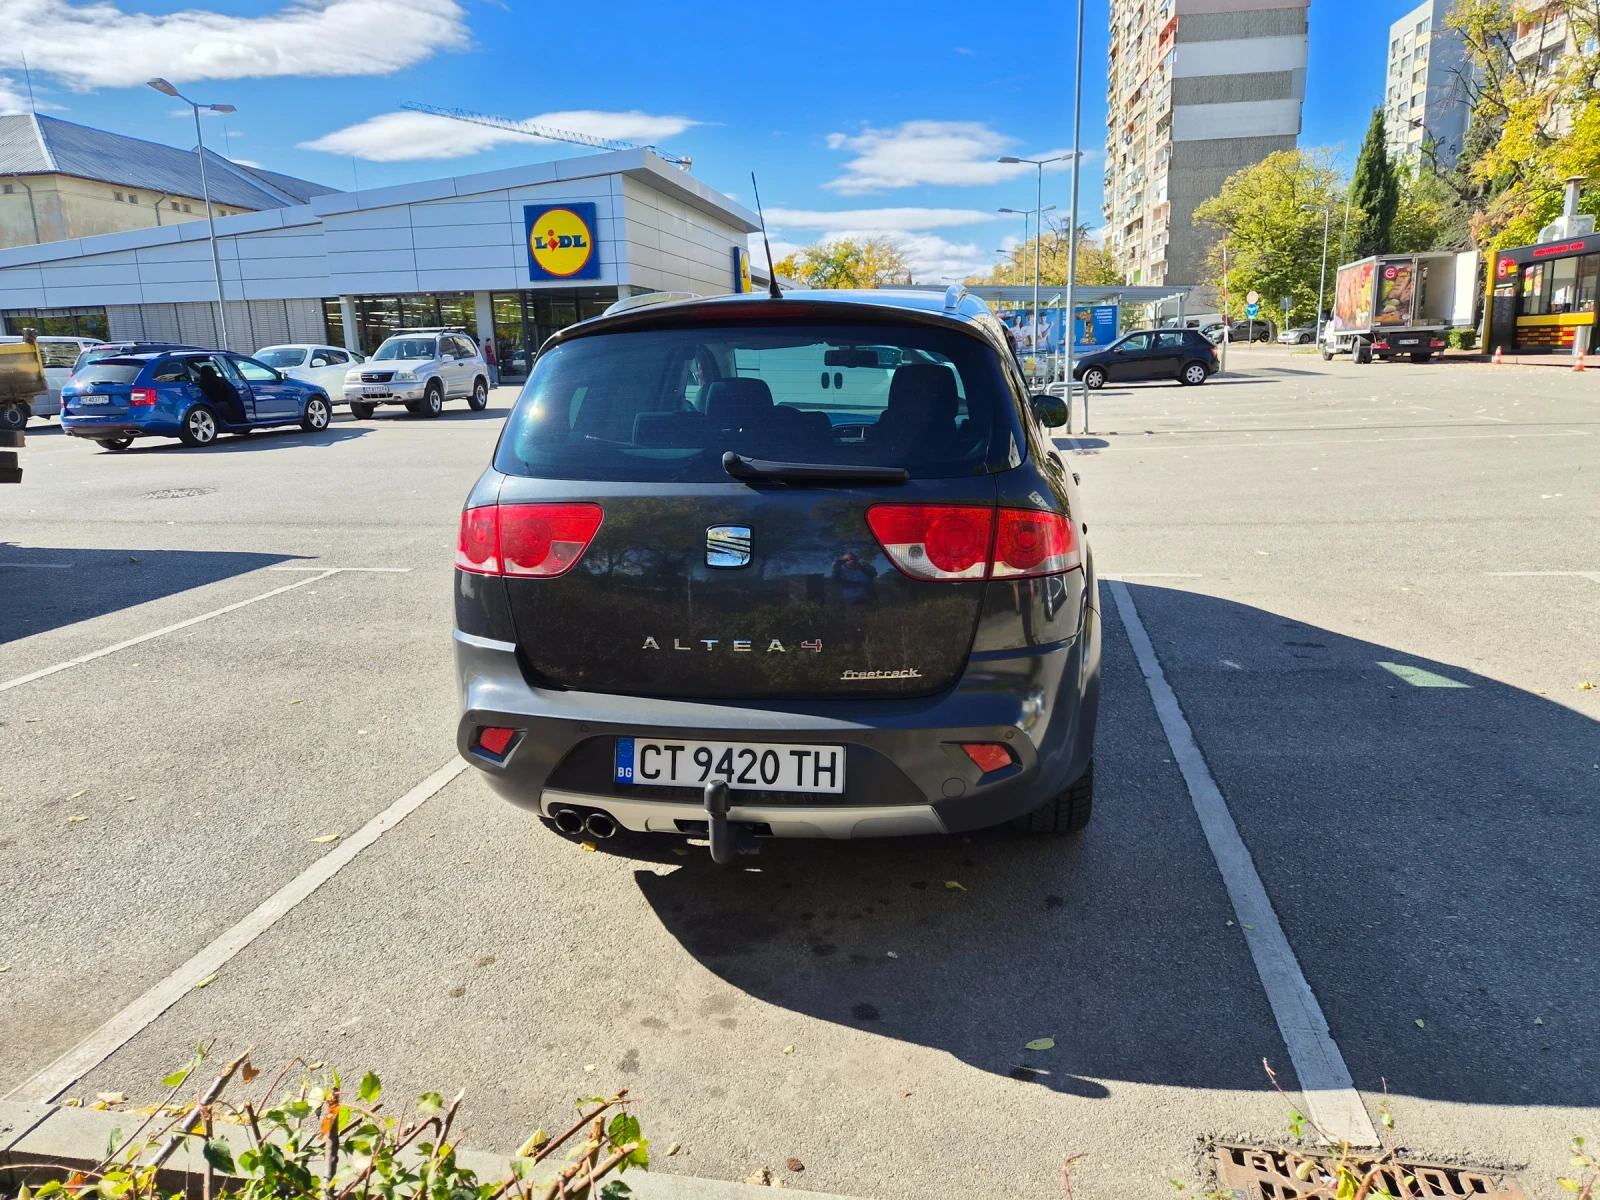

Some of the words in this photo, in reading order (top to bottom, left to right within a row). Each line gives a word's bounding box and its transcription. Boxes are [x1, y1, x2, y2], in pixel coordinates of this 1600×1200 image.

[642, 636, 786, 652] ALTEA
[842, 667, 921, 680] freetrack
[617, 766, 632, 778] BG
[640, 744, 685, 780] CT
[693, 747, 780, 785] 9420
[789, 750, 837, 787] TH
